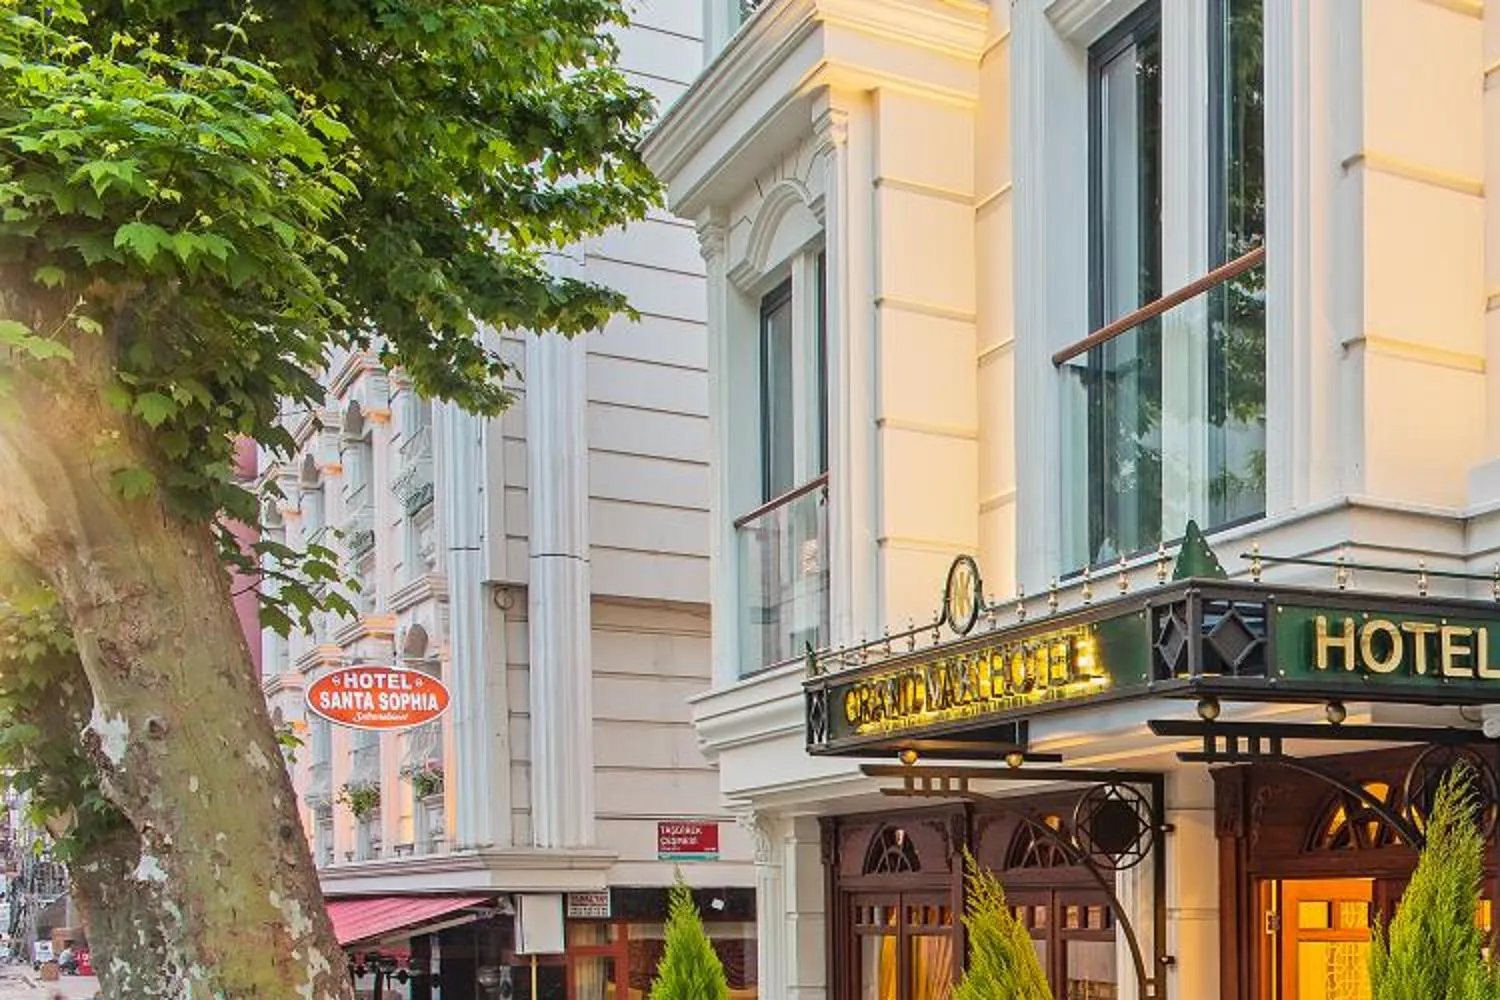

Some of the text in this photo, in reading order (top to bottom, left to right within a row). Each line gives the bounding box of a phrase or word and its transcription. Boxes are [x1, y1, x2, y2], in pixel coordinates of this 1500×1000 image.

[343, 671, 412, 689] HOTEL
[844, 668, 925, 725] GRAND
[991, 632, 1105, 698] HOTEL
[319, 690, 439, 711] SANTA SOPHIA
